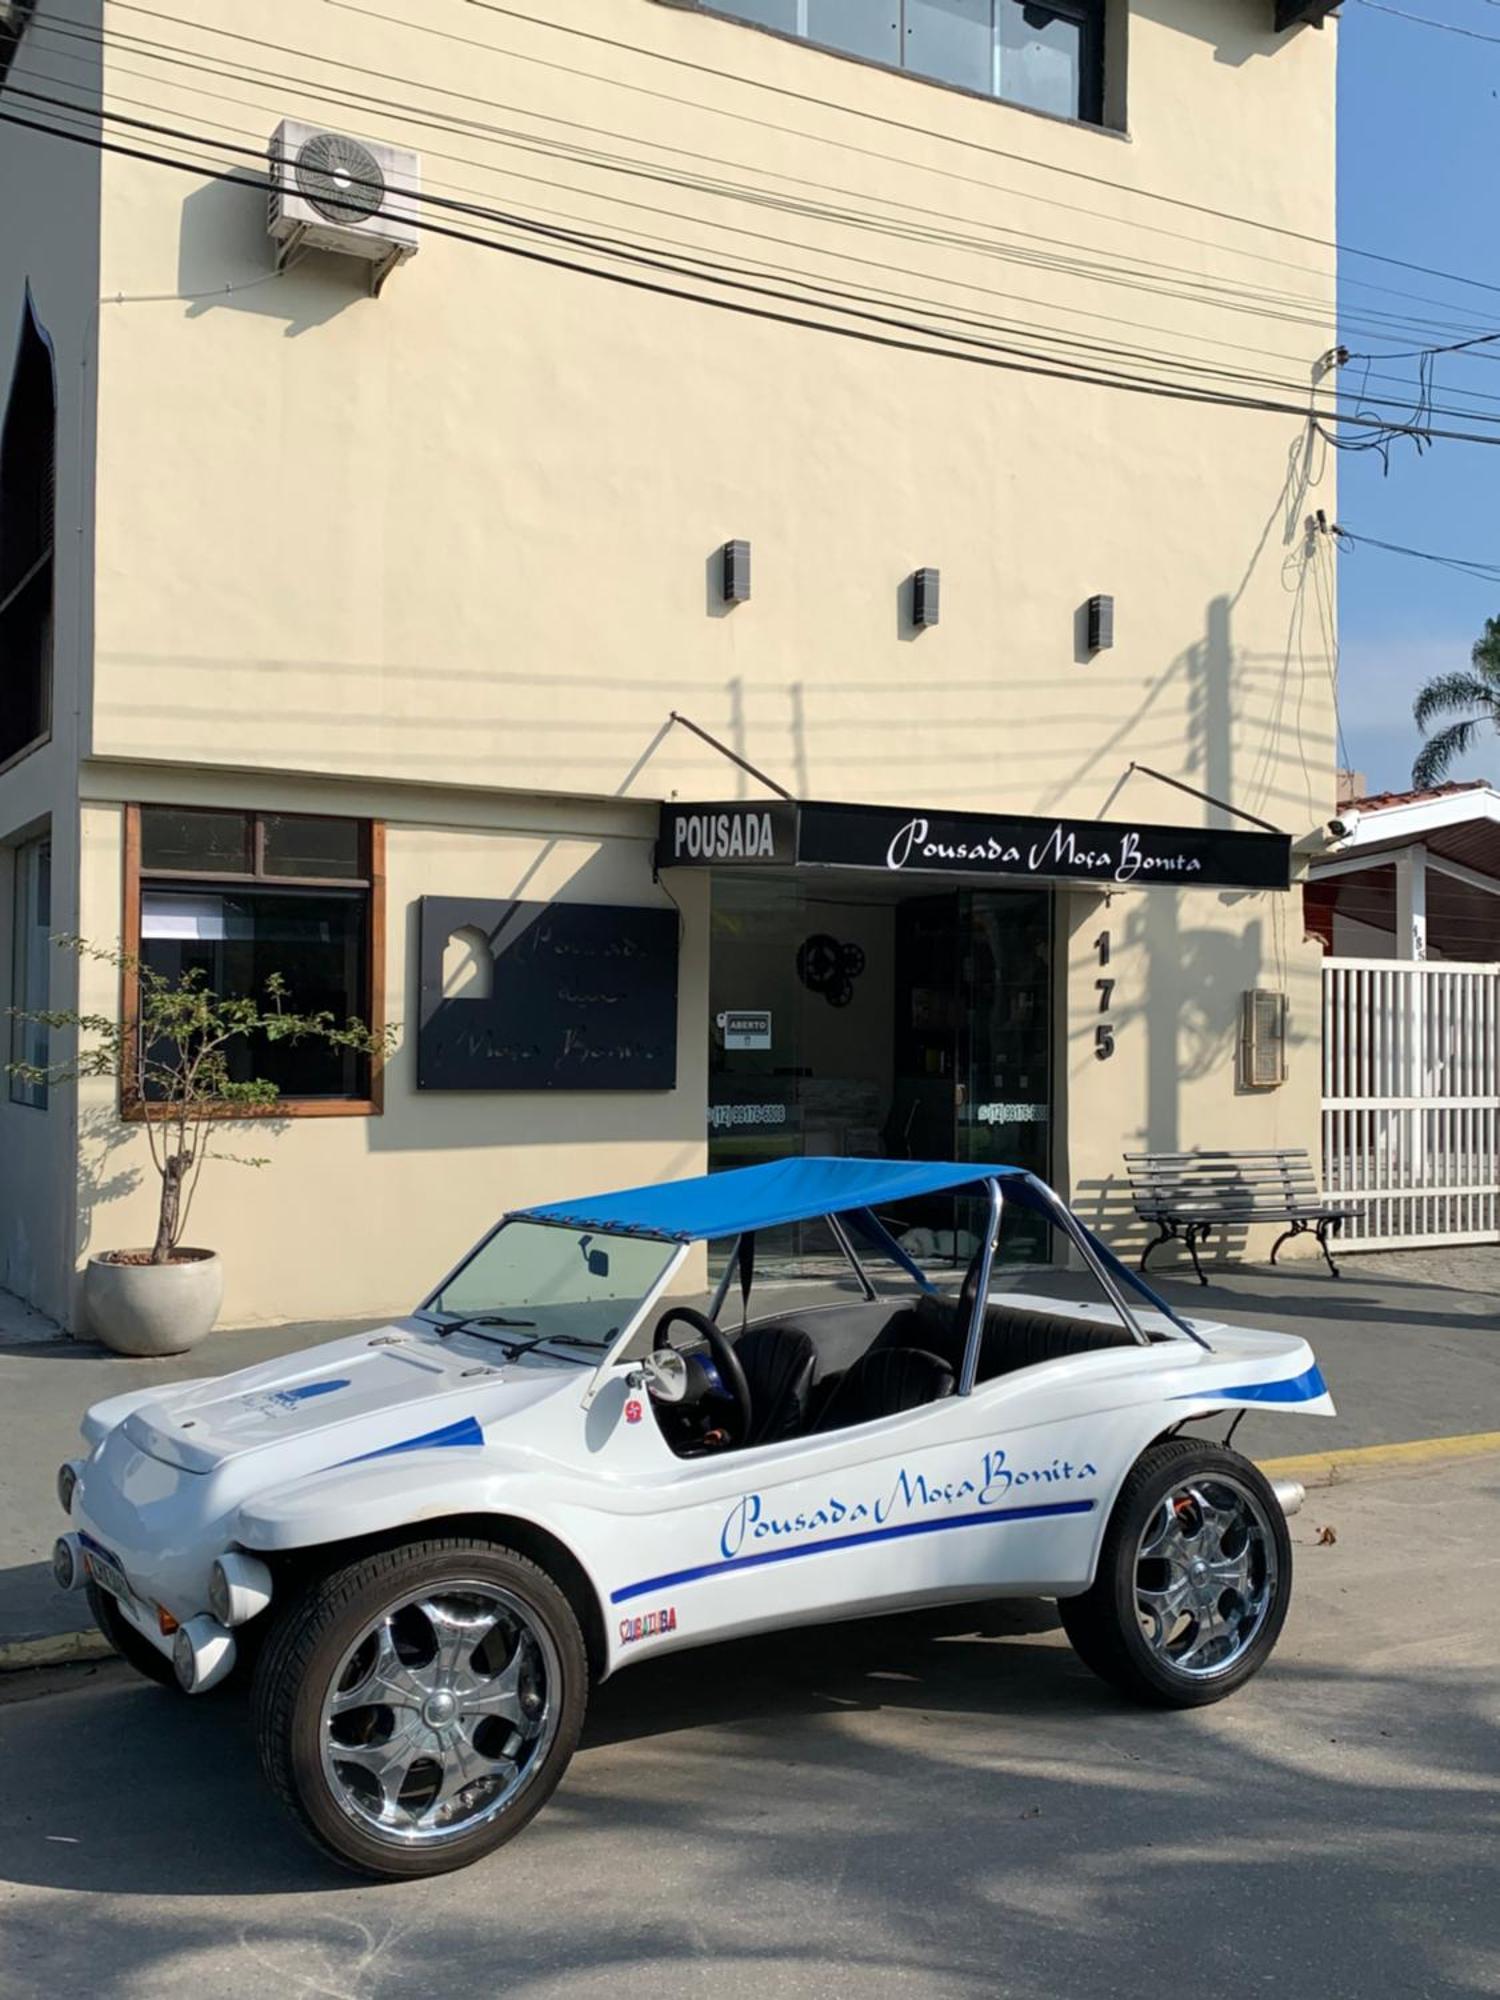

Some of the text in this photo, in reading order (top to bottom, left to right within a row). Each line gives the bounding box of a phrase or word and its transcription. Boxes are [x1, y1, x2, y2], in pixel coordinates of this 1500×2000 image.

[674, 812, 775, 858] POUSADA
[887, 817, 1202, 883] Pousada Moça Bonita
[729, 1020, 767, 1030] ABERTO
[1093, 930, 1116, 1061] 175
[720, 1449, 1098, 1559] Pousada Moça Bonita
